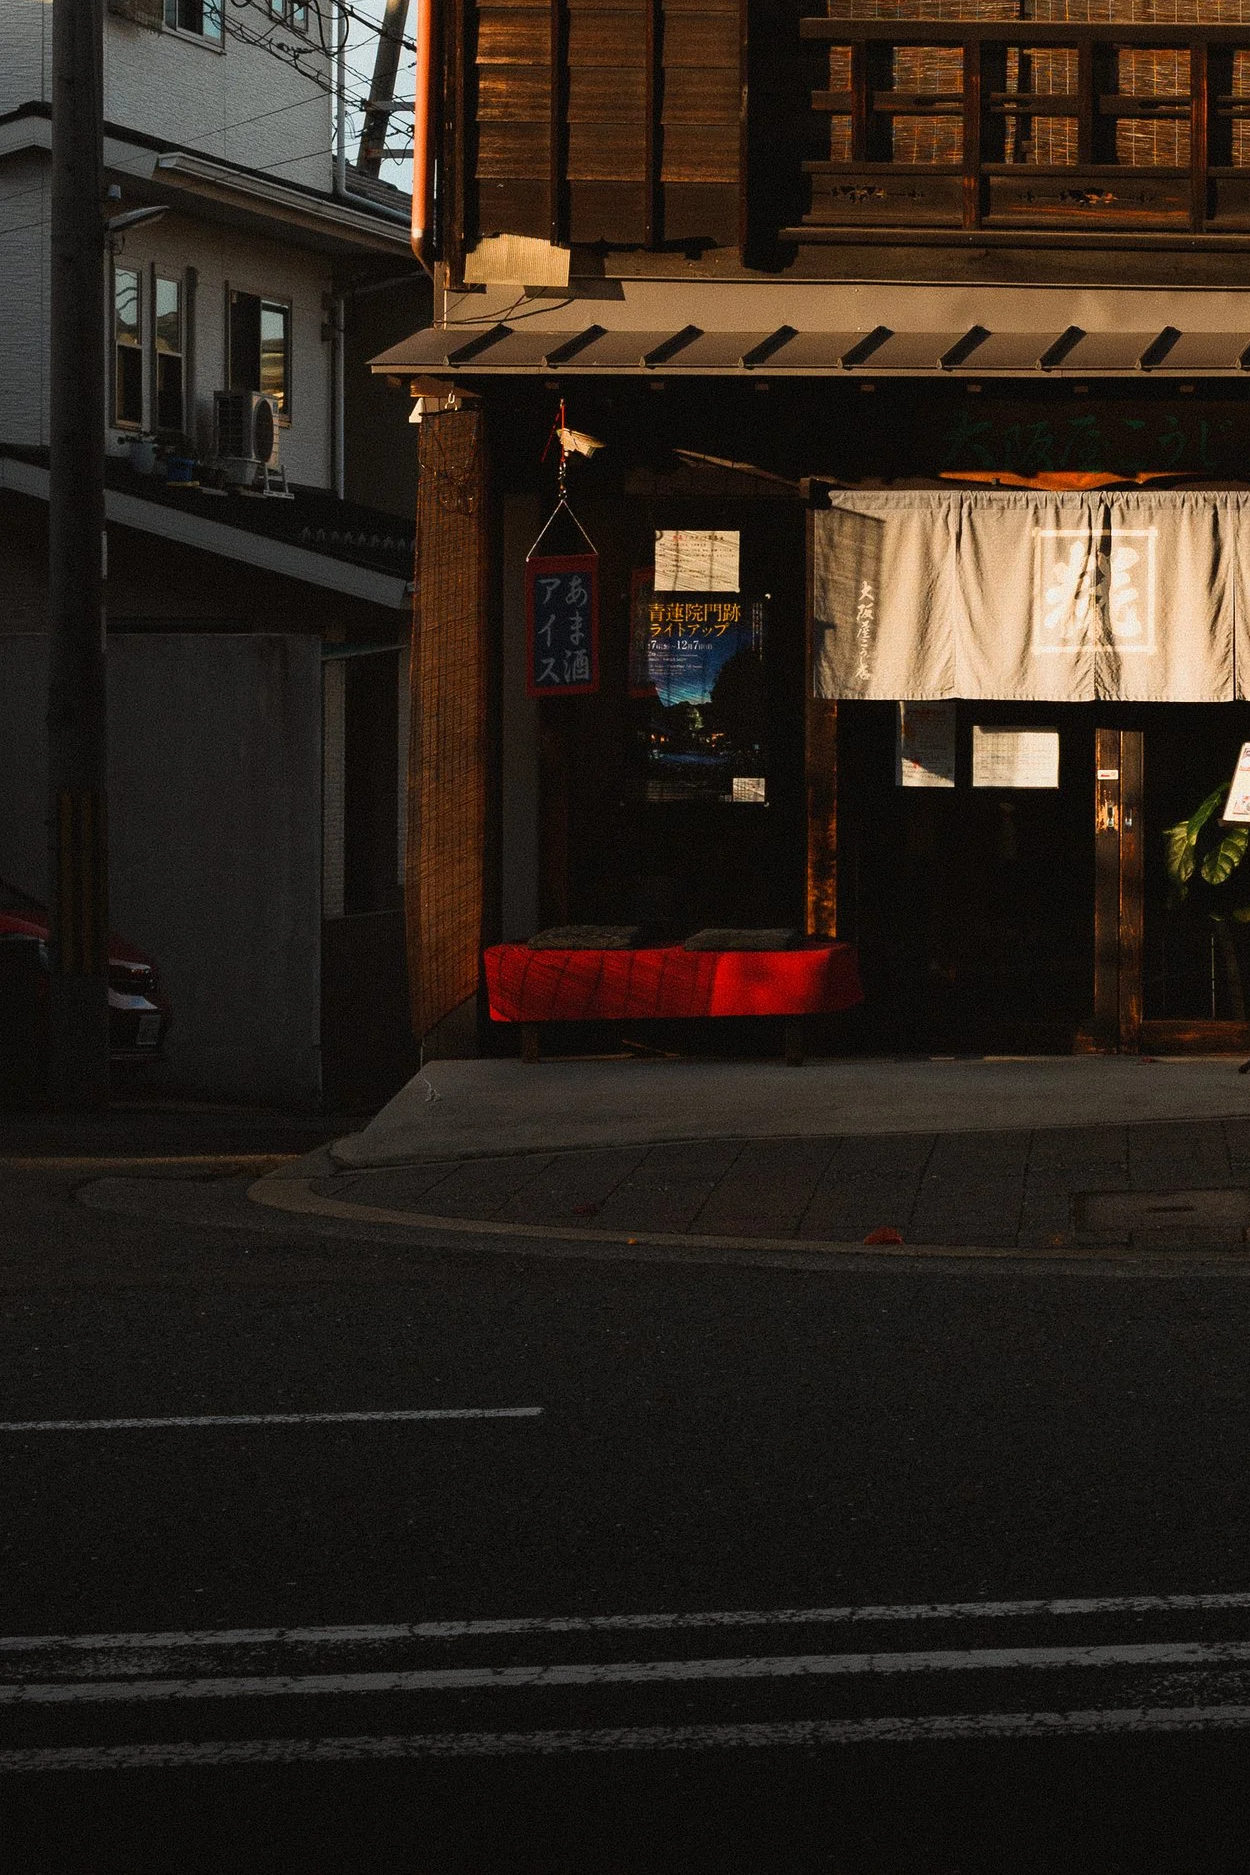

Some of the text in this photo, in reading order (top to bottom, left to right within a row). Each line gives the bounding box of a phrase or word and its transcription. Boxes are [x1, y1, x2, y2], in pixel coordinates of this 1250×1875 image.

[536, 577, 561, 683] アイス
[564, 575, 590, 682] あま酒
[649, 603, 741, 623] 青蓮院門跡
[650, 623, 728, 637] ライトアップ
